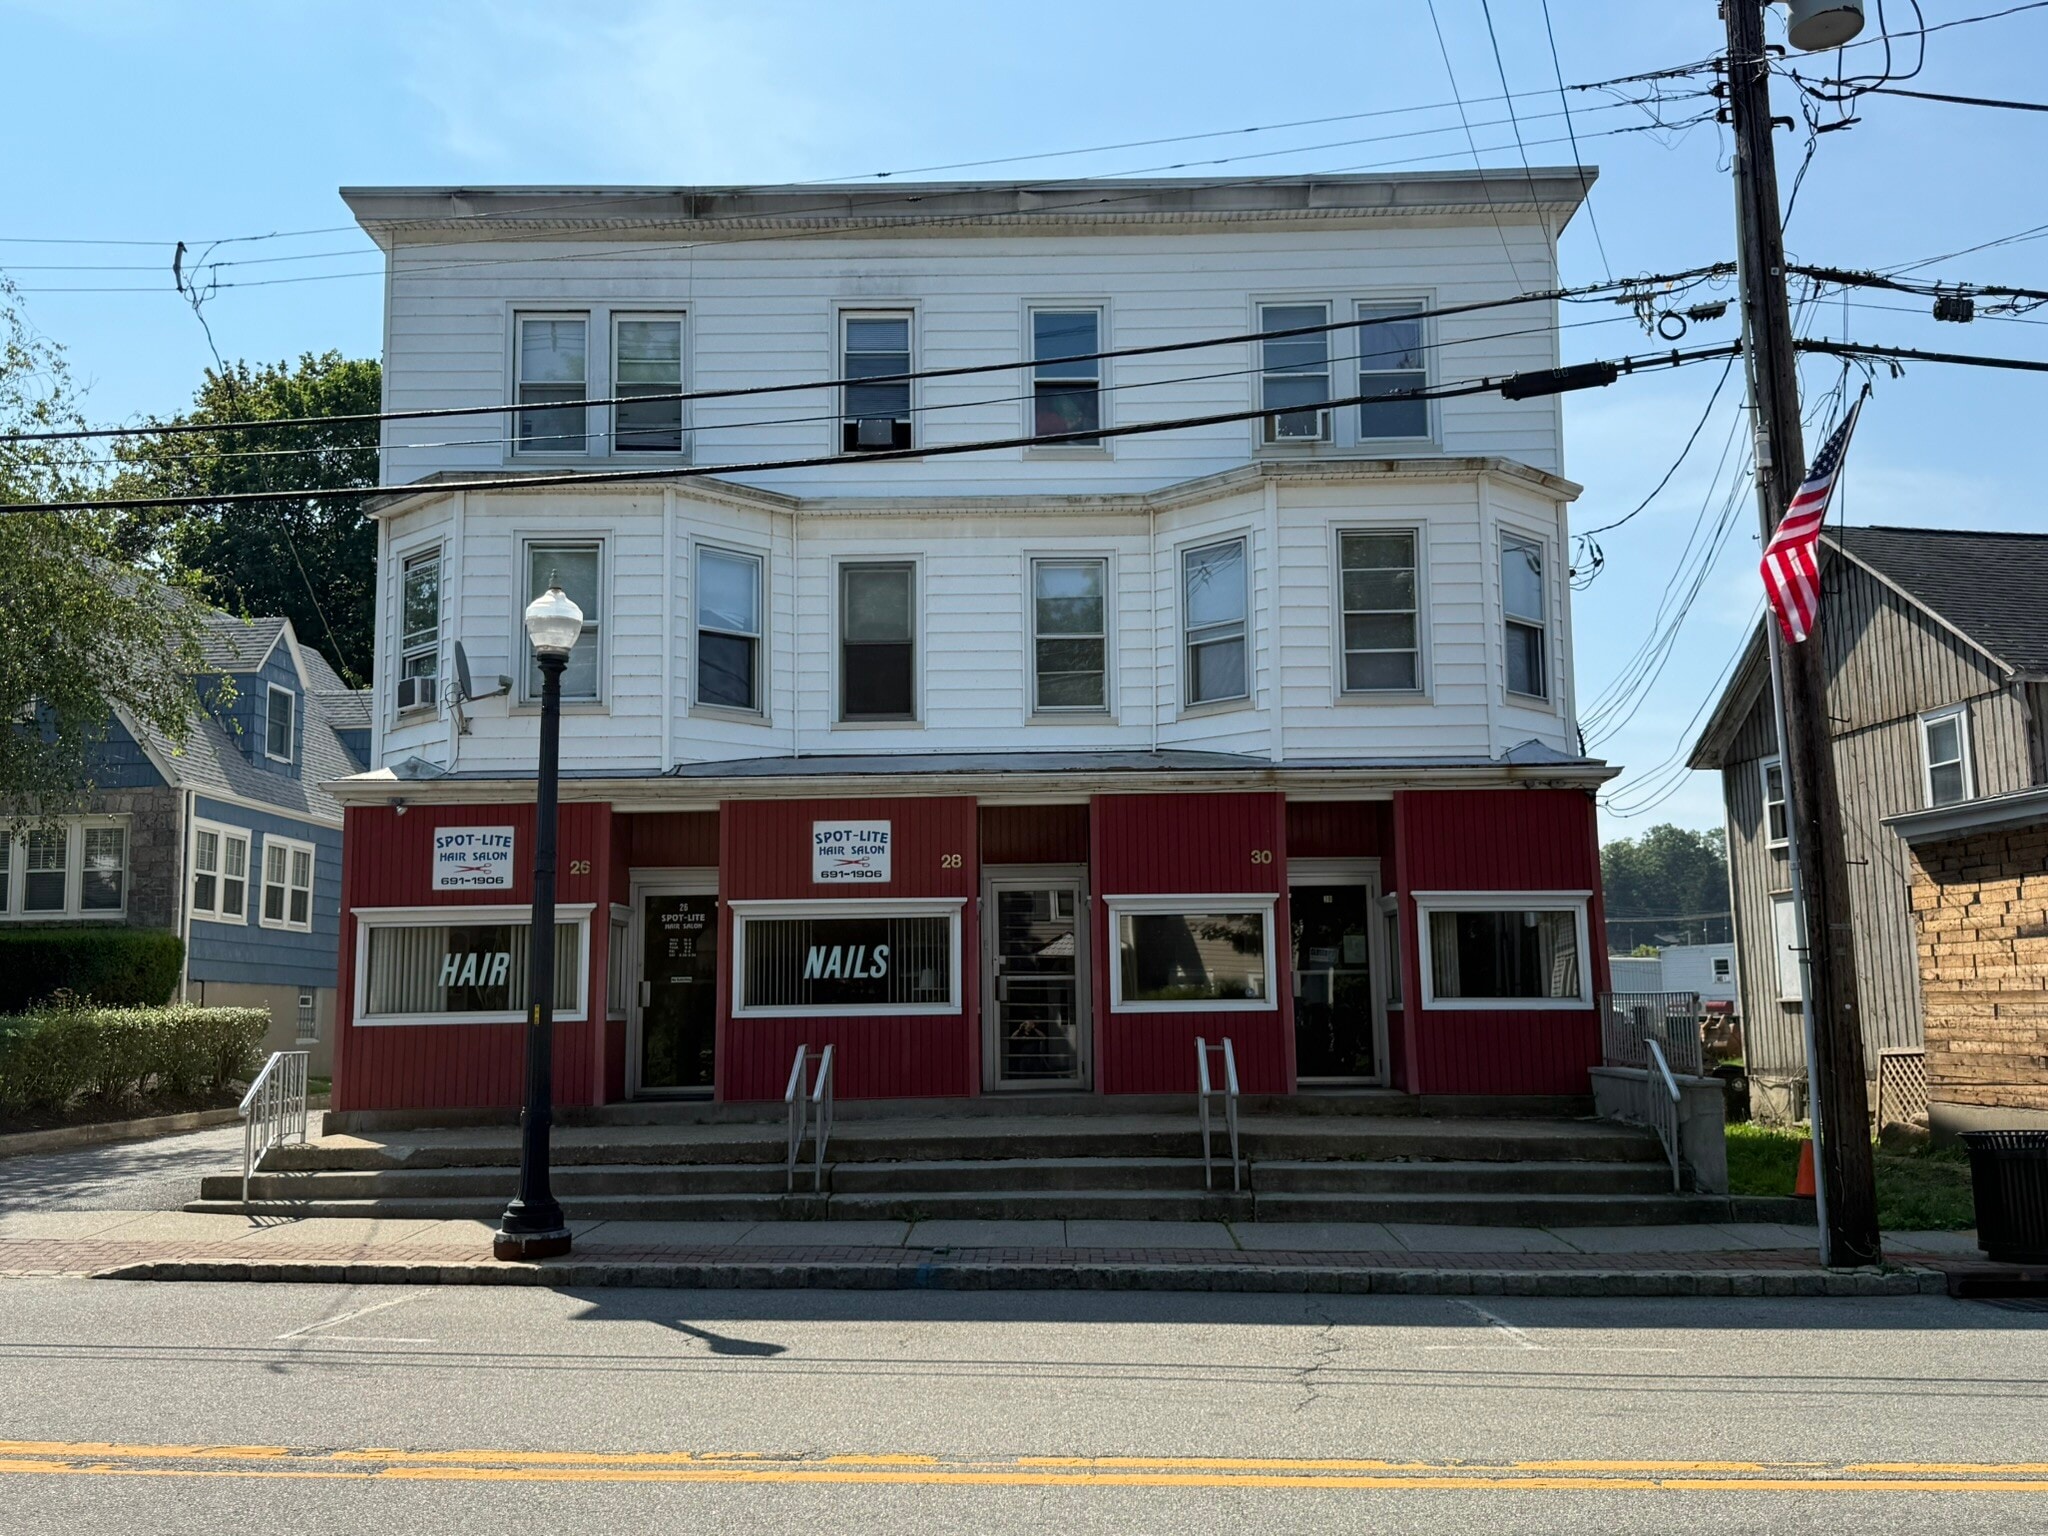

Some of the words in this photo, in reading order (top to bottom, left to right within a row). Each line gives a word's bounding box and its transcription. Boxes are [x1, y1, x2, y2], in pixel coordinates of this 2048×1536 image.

[436, 834, 512, 848] SPOT-LITE
[815, 830, 889, 844] SPOT-LITE
[440, 852, 466, 862] HAIR
[472, 852, 508, 861] SALON
[819, 846, 845, 856] HAIR
[851, 845, 885, 855] SALON
[1251, 850, 1272, 864] 30
[570, 860, 591, 874] 26
[941, 854, 962, 868] 28
[441, 877, 504, 885] 691-1906
[821, 870, 882, 878] 691-1906
[661, 914, 706, 922] SPOT-LITE
[803, 944, 890, 979] NAILS
[438, 952, 511, 987] HAIR
